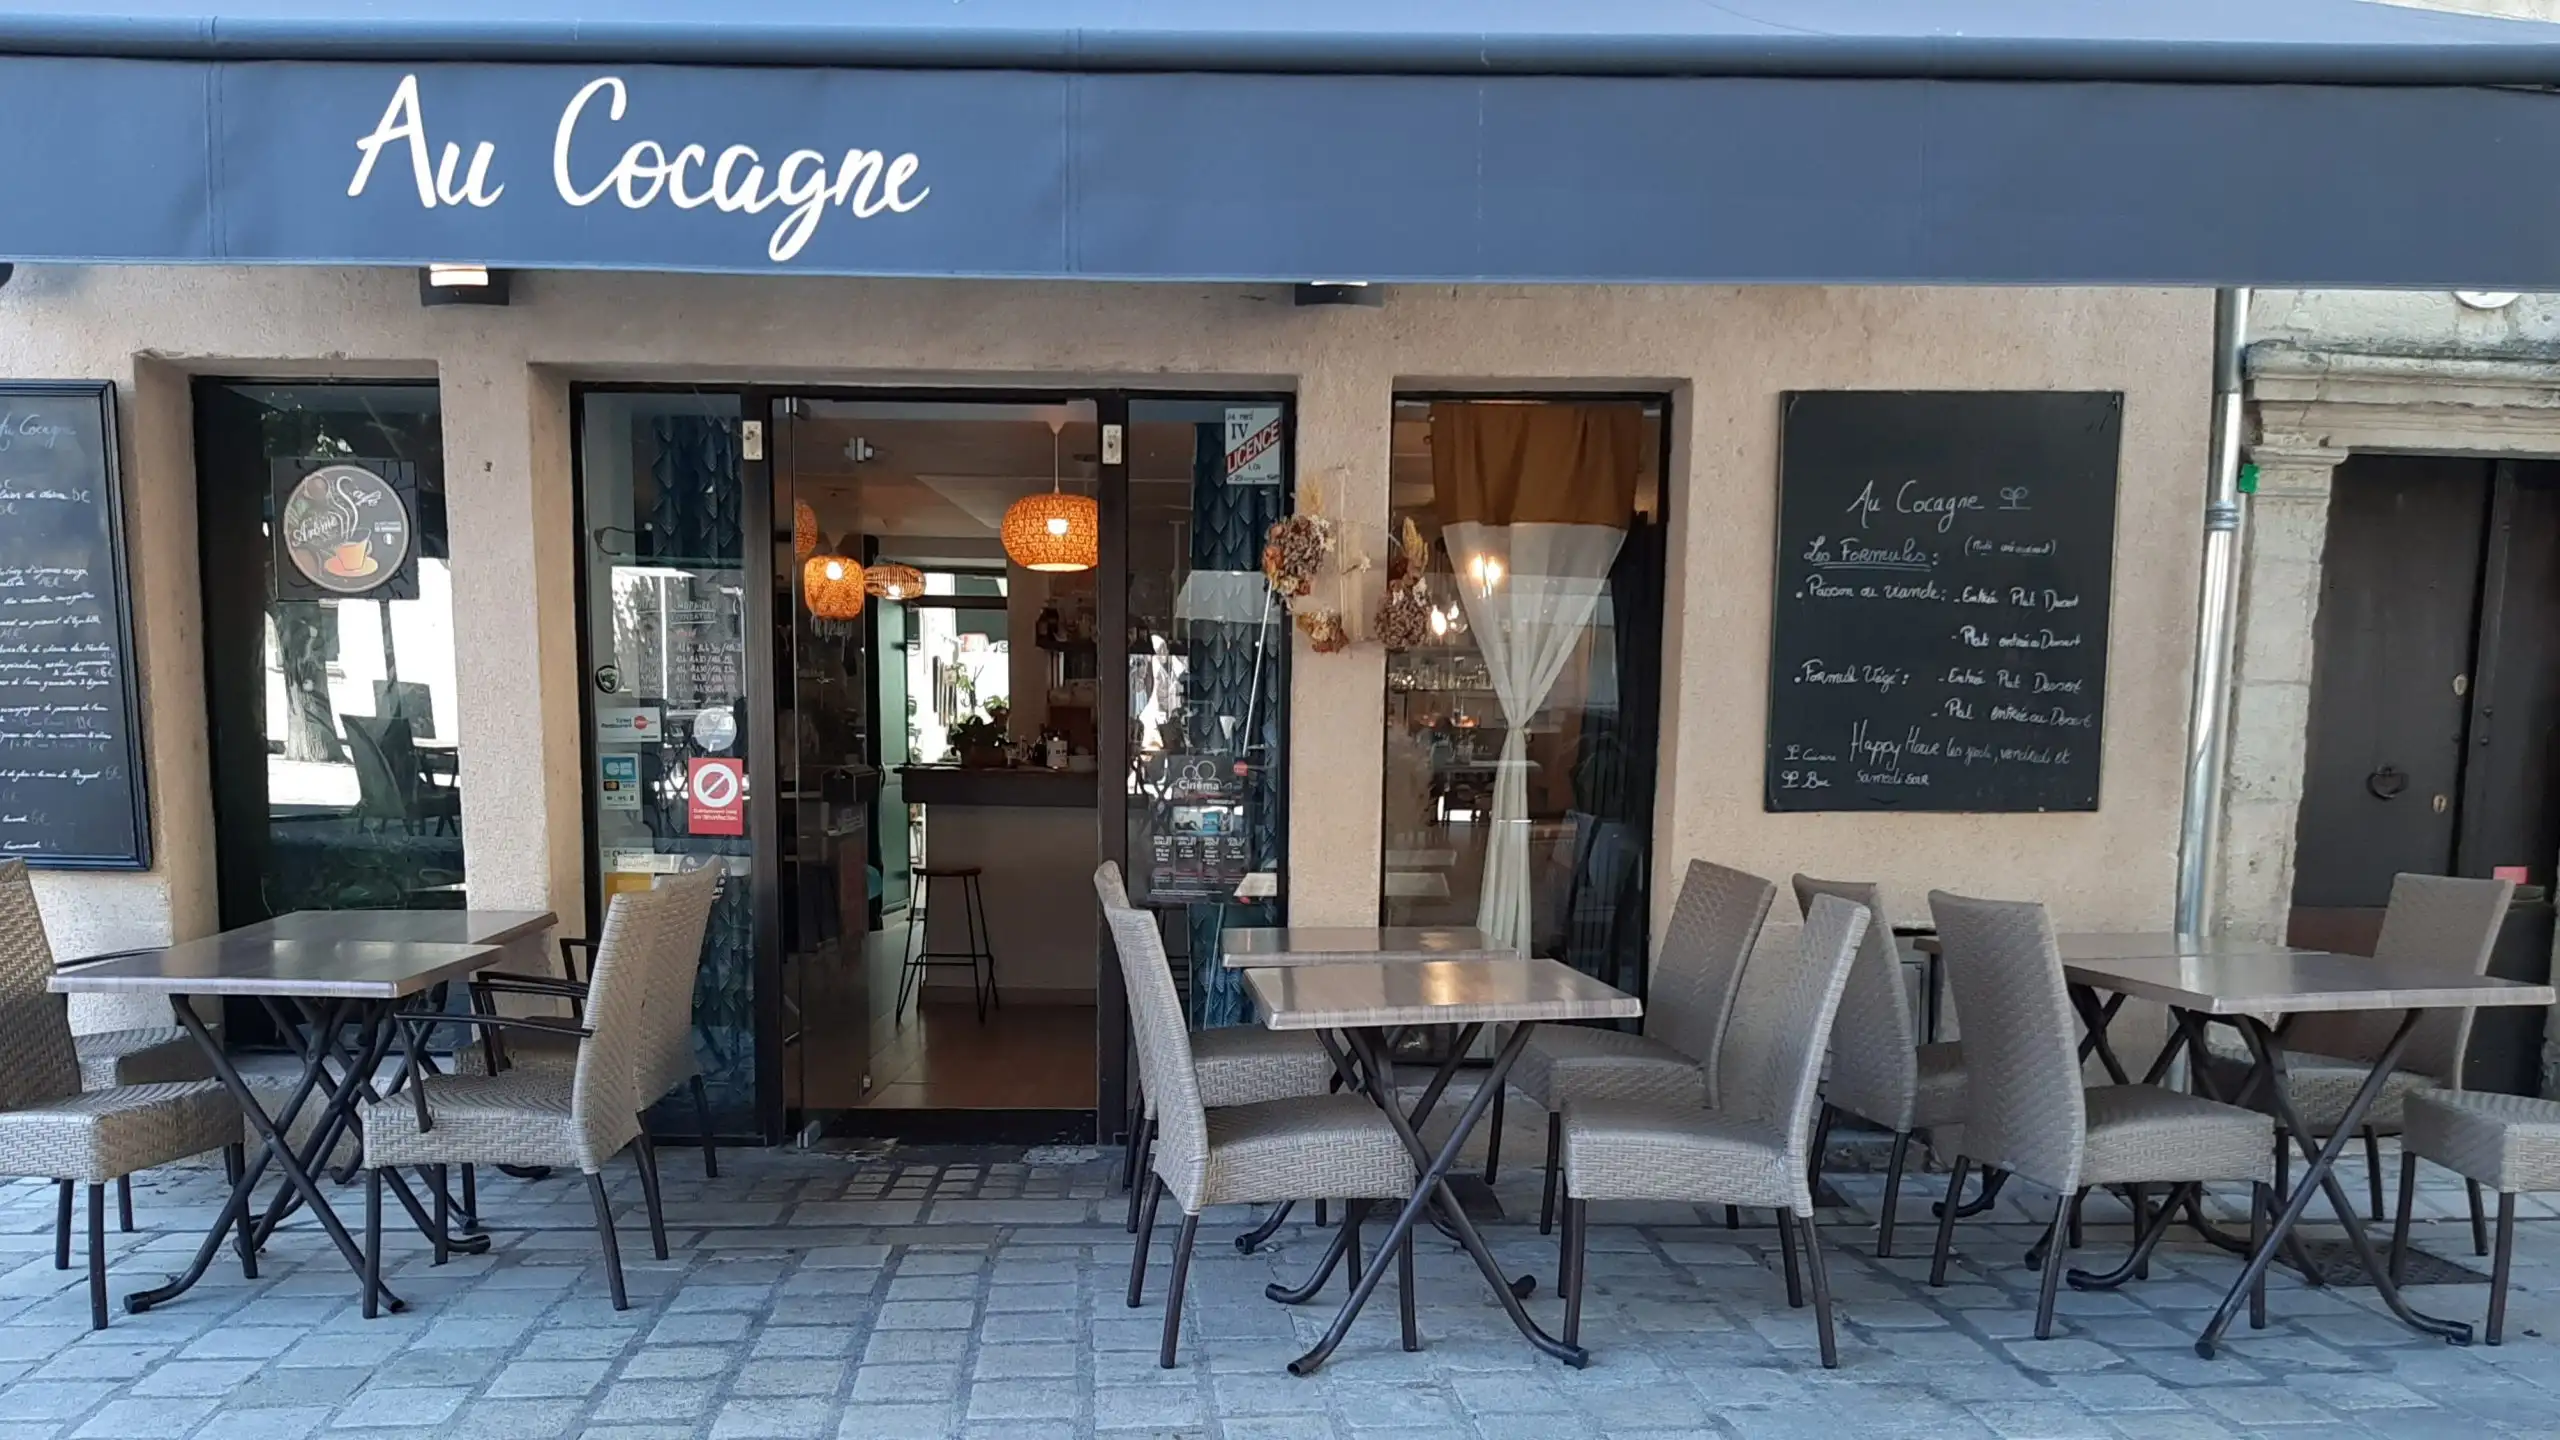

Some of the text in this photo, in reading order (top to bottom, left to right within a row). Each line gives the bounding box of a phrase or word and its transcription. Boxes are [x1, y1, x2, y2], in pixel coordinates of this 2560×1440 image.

[347, 74, 930, 261] Au Cocagne
[1227, 420, 1280, 474] LICENCE
[1231, 423, 1249, 440] IV
[1846, 480, 1984, 533] Au Cocagne
[1849, 719, 1902, 771] Happy
[2054, 751, 2071, 764] et
[1178, 778, 1220, 792] Cinéma
